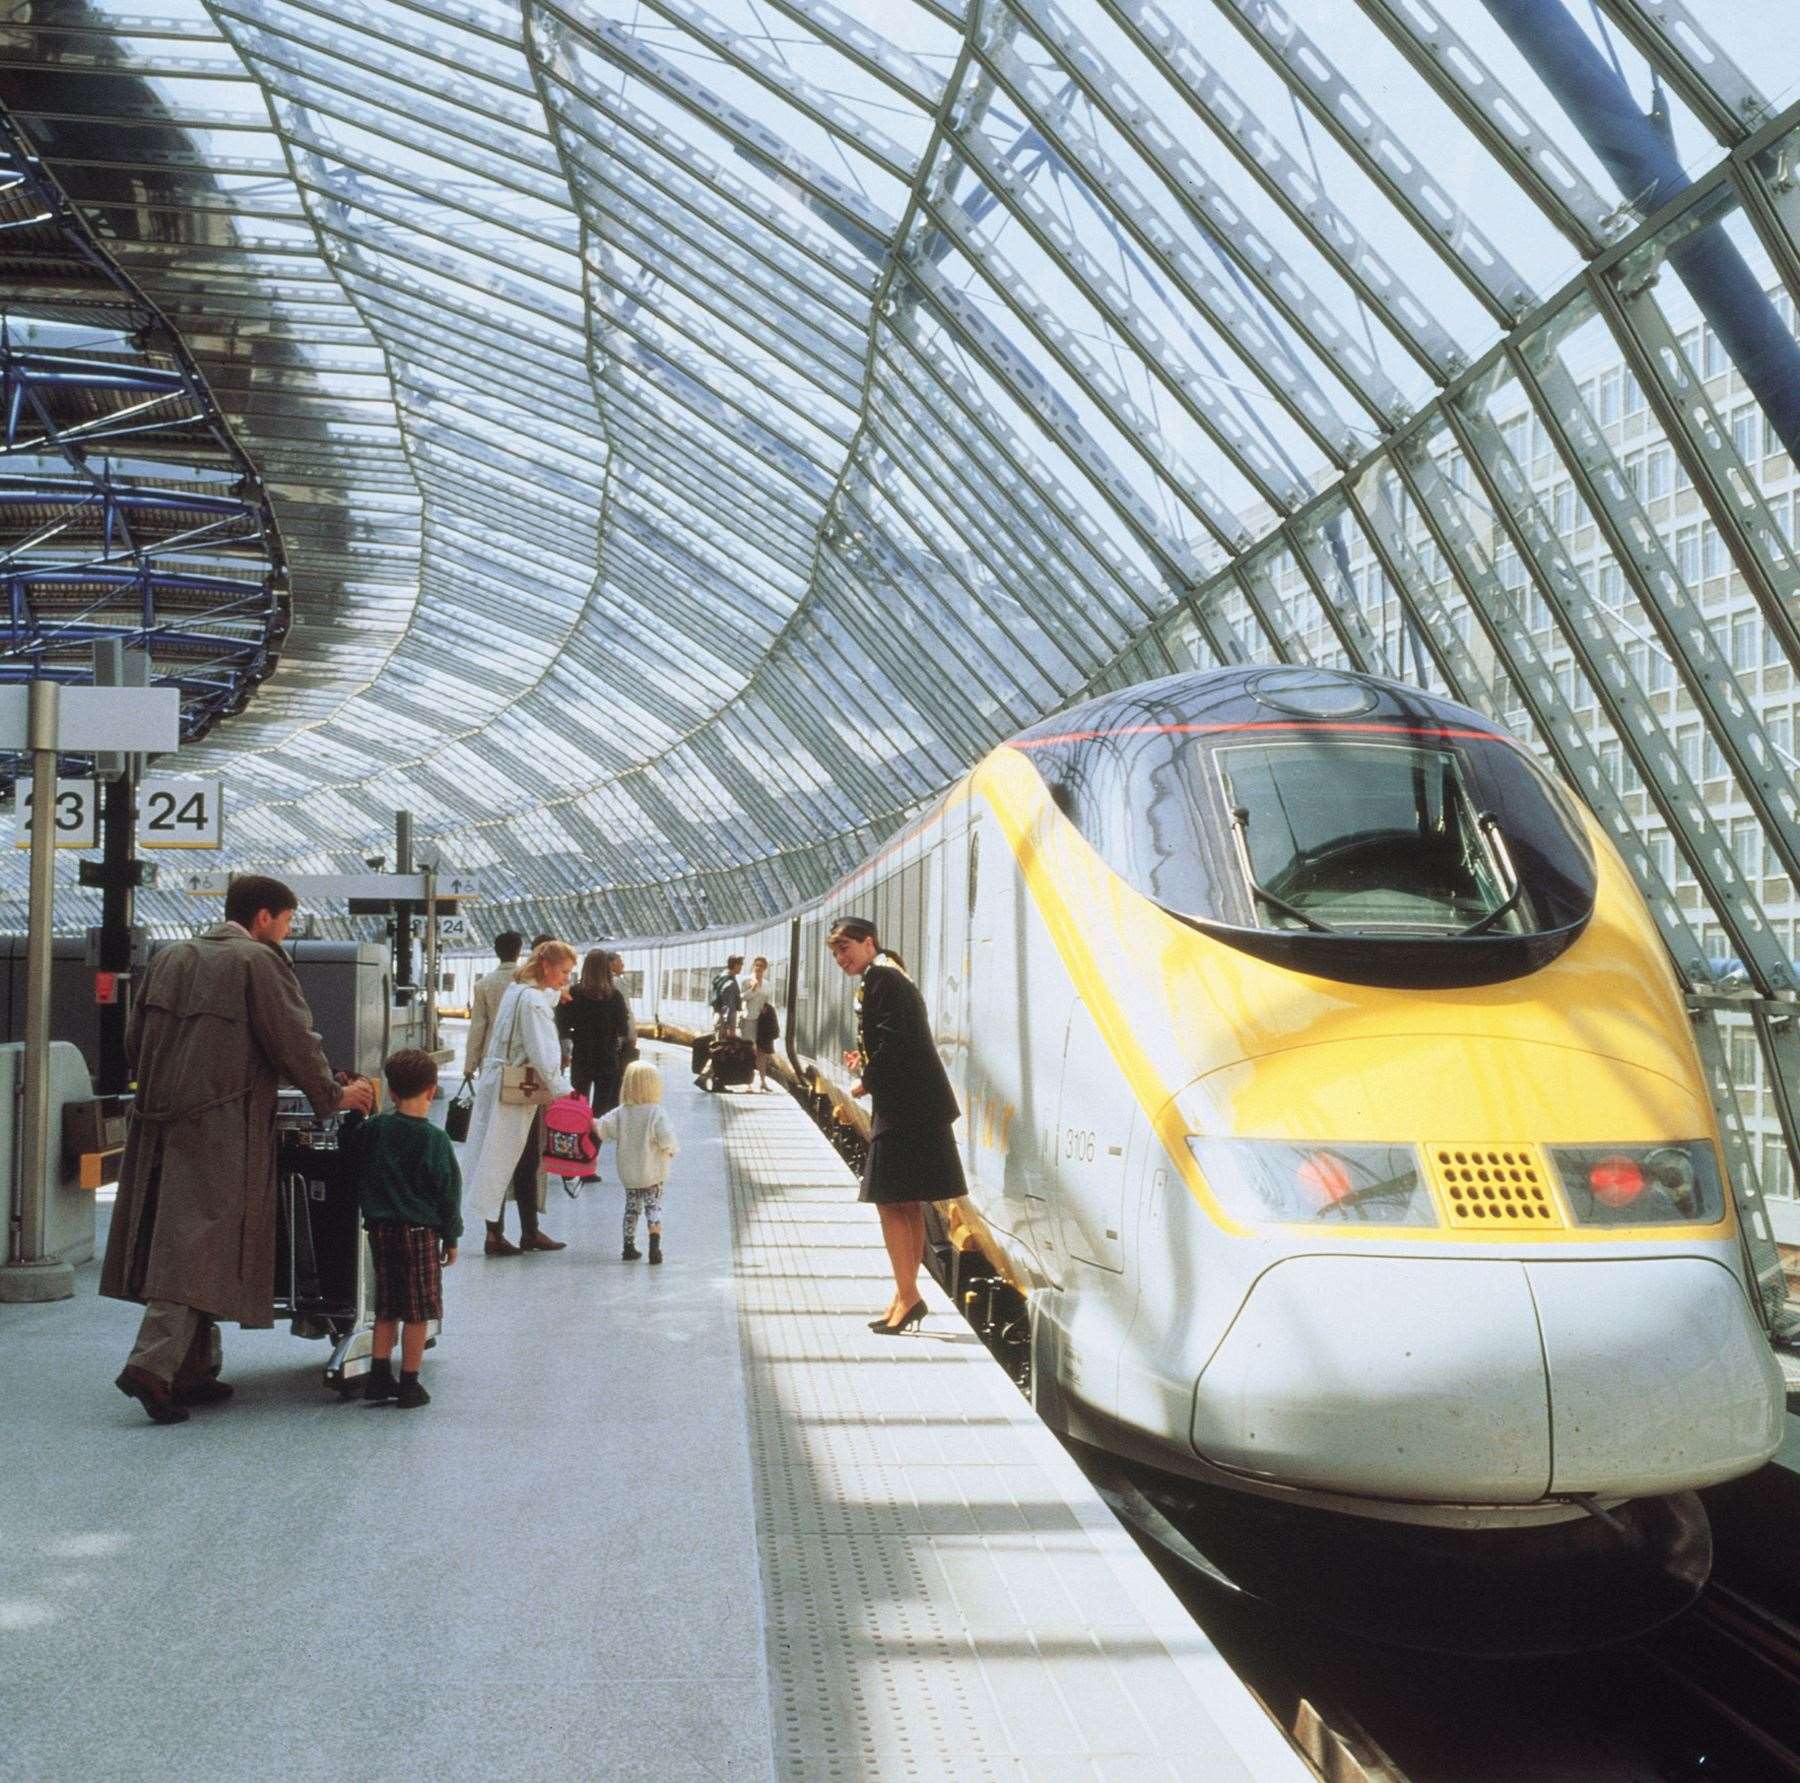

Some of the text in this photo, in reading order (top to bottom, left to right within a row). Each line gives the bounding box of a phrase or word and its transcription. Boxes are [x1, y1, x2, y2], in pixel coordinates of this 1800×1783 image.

[148, 791, 209, 831] 24
[443, 919, 465, 934] 24
[1065, 1128, 1096, 1162] 3106
